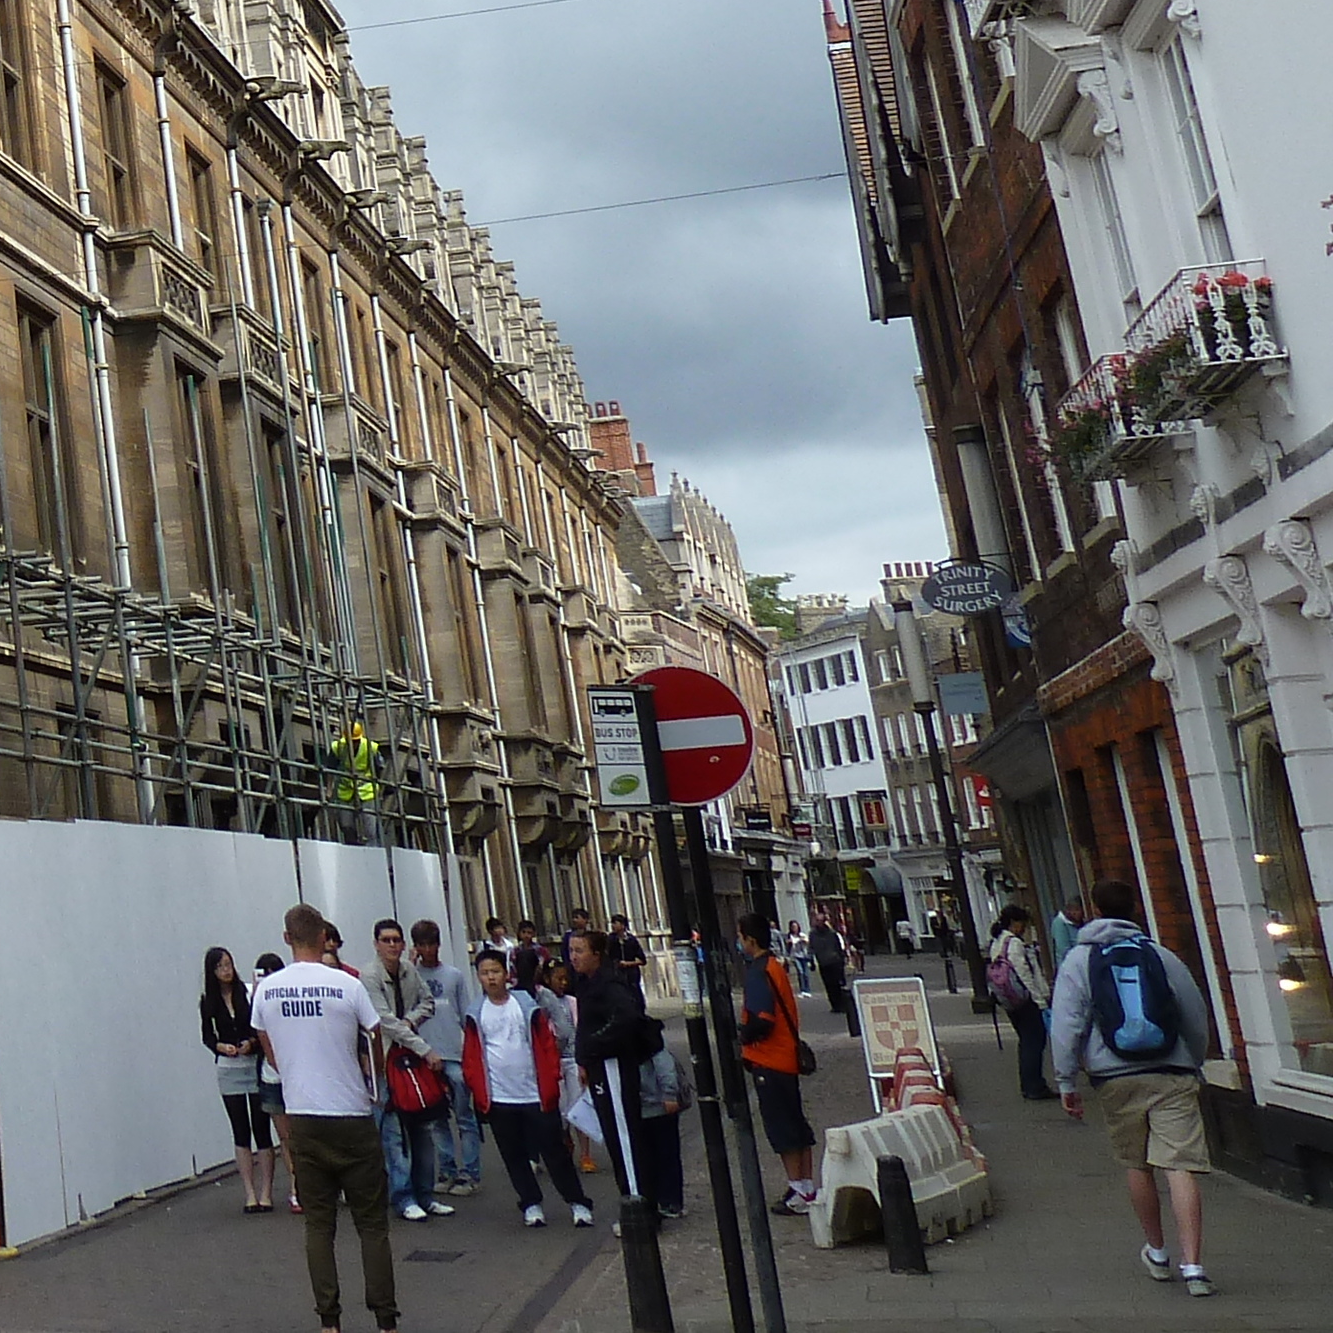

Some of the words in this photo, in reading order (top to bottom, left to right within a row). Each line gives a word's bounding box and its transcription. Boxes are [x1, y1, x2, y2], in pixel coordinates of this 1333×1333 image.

[934, 566, 994, 585] TRINITY
[940, 581, 991, 598] STREET
[933, 590, 1002, 612] SURGERY
[595, 727, 613, 738] BUS
[616, 727, 638, 738] STOP
[264, 987, 300, 1001] OFFICIAL
[301, 985, 344, 1000] PUNTING
[281, 1000, 324, 1017] GUIDE
